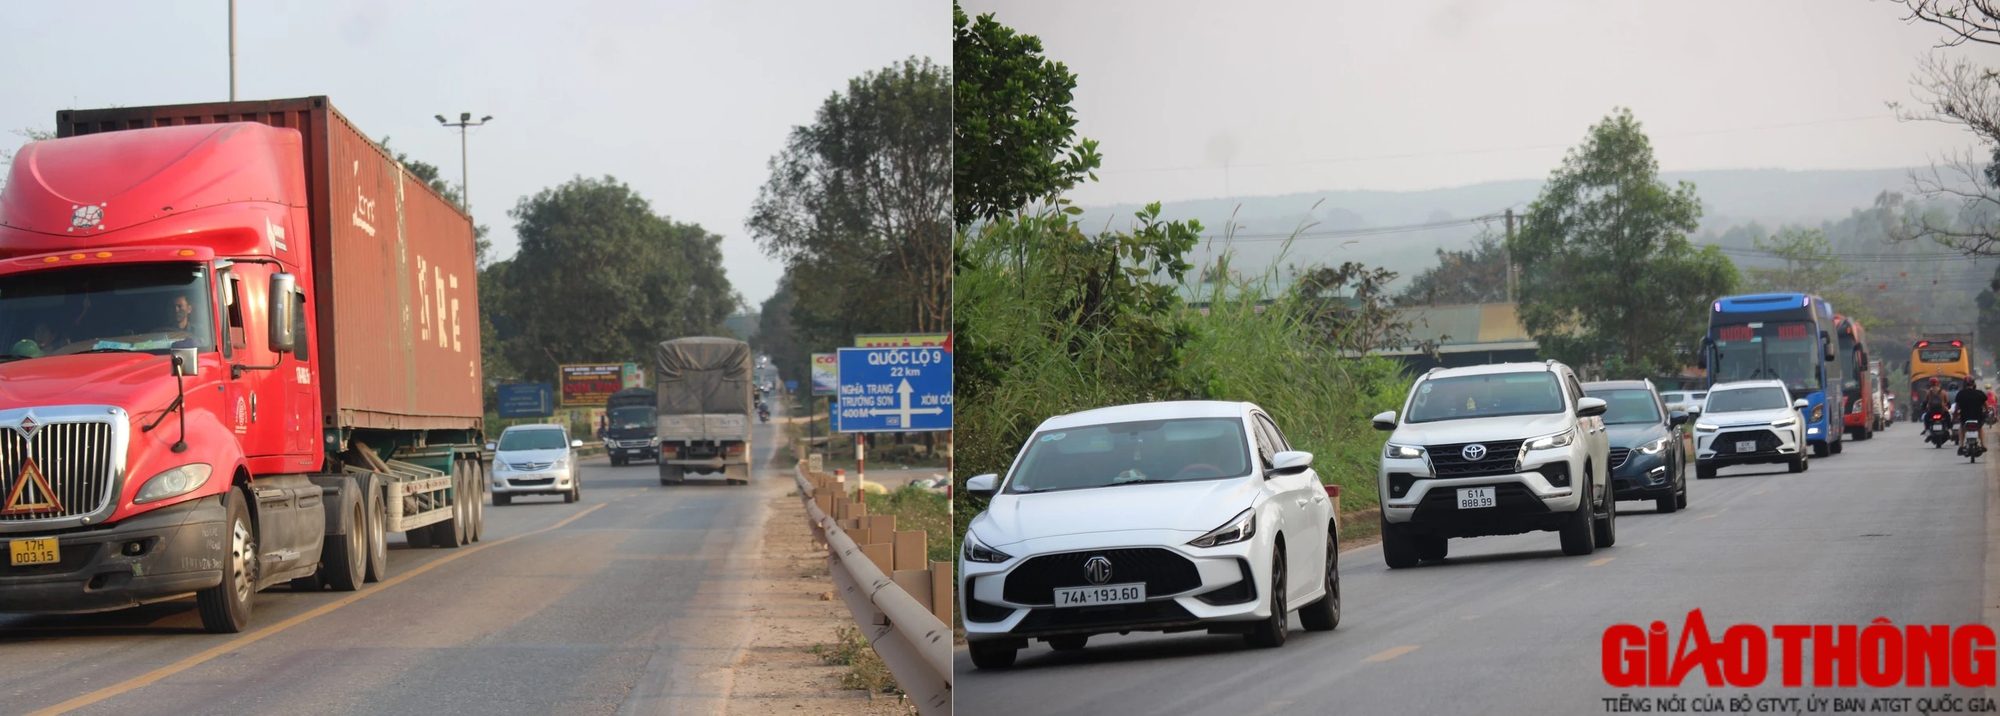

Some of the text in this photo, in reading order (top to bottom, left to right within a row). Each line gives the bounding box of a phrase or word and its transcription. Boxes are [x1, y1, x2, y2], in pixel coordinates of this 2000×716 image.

[868, 349, 941, 367] QUỐC LỘ 9
[891, 367, 921, 377] 22 km
[841, 383, 894, 394] NGHĨA TRANG
[877, 396, 894, 406] SƠN
[921, 393, 938, 405] XÓM
[1468, 489, 1485, 498] 61A
[1462, 497, 1492, 508] 888.99
[25, 540, 44, 551] 17H
[16, 551, 54, 563] 003.15
[1086, 558, 1111, 583] MG
[1062, 587, 1139, 604] 74A-193.60
